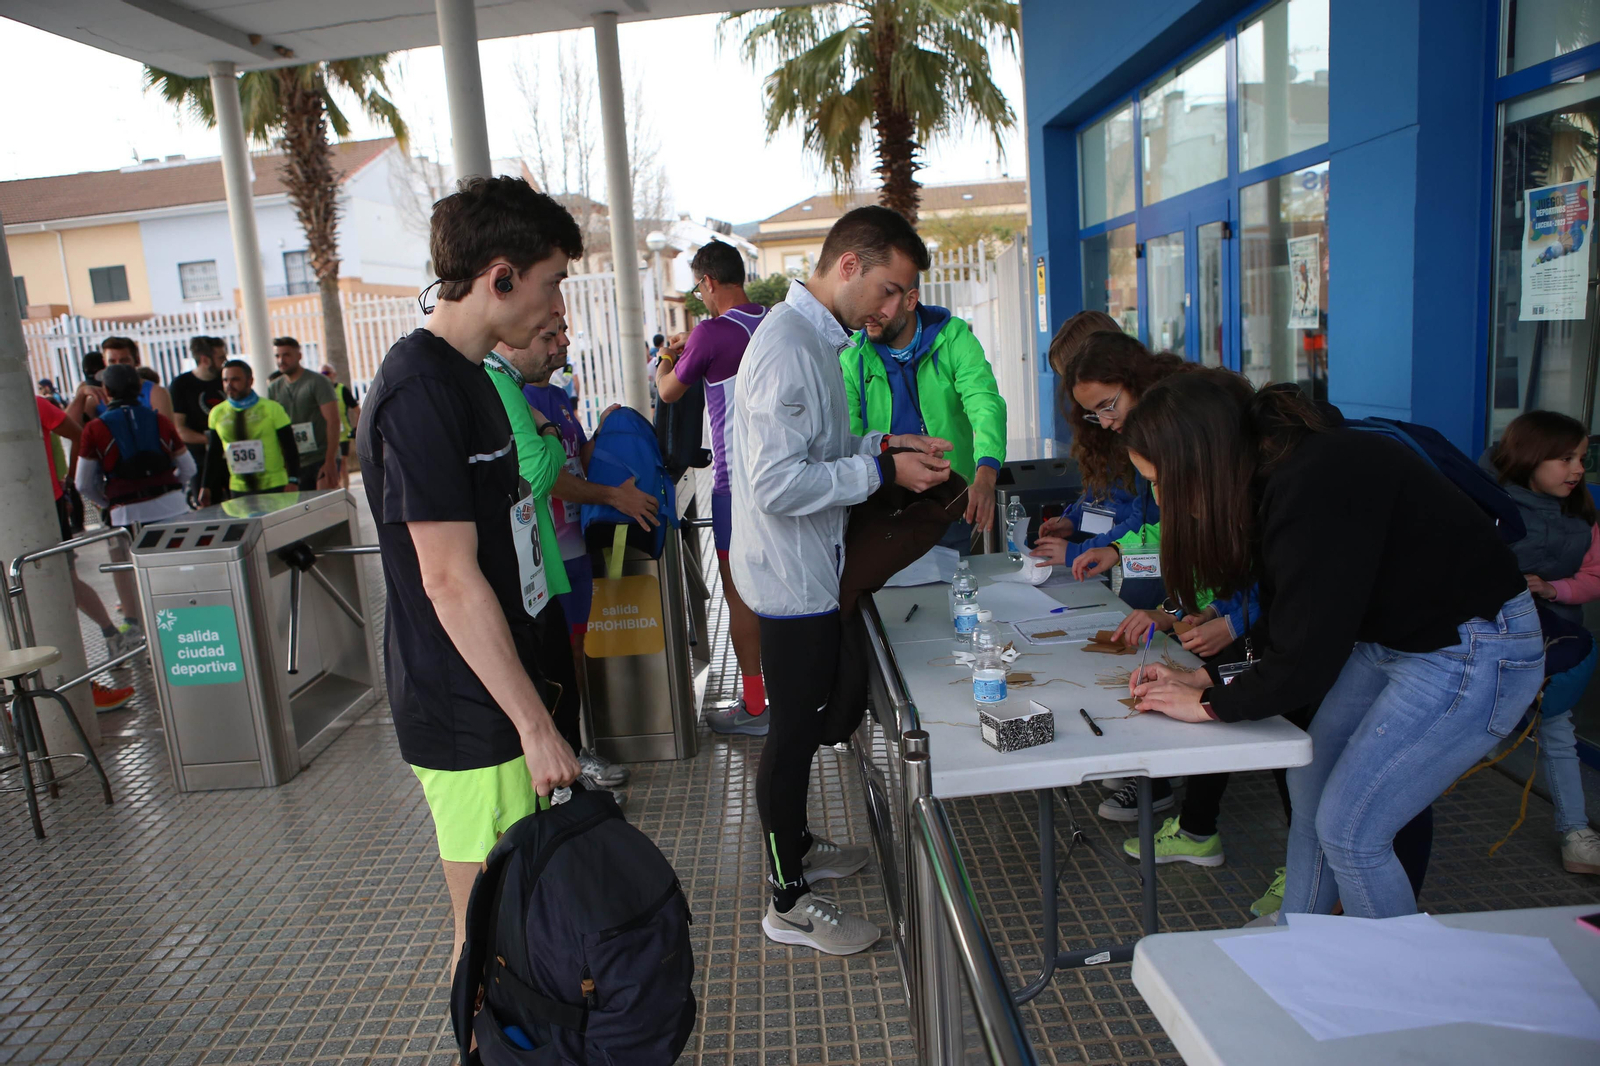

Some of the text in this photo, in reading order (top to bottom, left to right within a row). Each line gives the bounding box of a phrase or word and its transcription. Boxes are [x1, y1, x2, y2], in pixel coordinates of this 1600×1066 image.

[1536, 195, 1565, 210] JUEGOS
[1536, 205, 1566, 217] DEPORTIVOS
[232, 448, 256, 462] 536
[602, 604, 639, 616] salida
[587, 617, 658, 632] PROHIBIDA
[177, 630, 220, 644] salida
[177, 644, 225, 659] ciudad
[171, 661, 237, 677] deportiva
